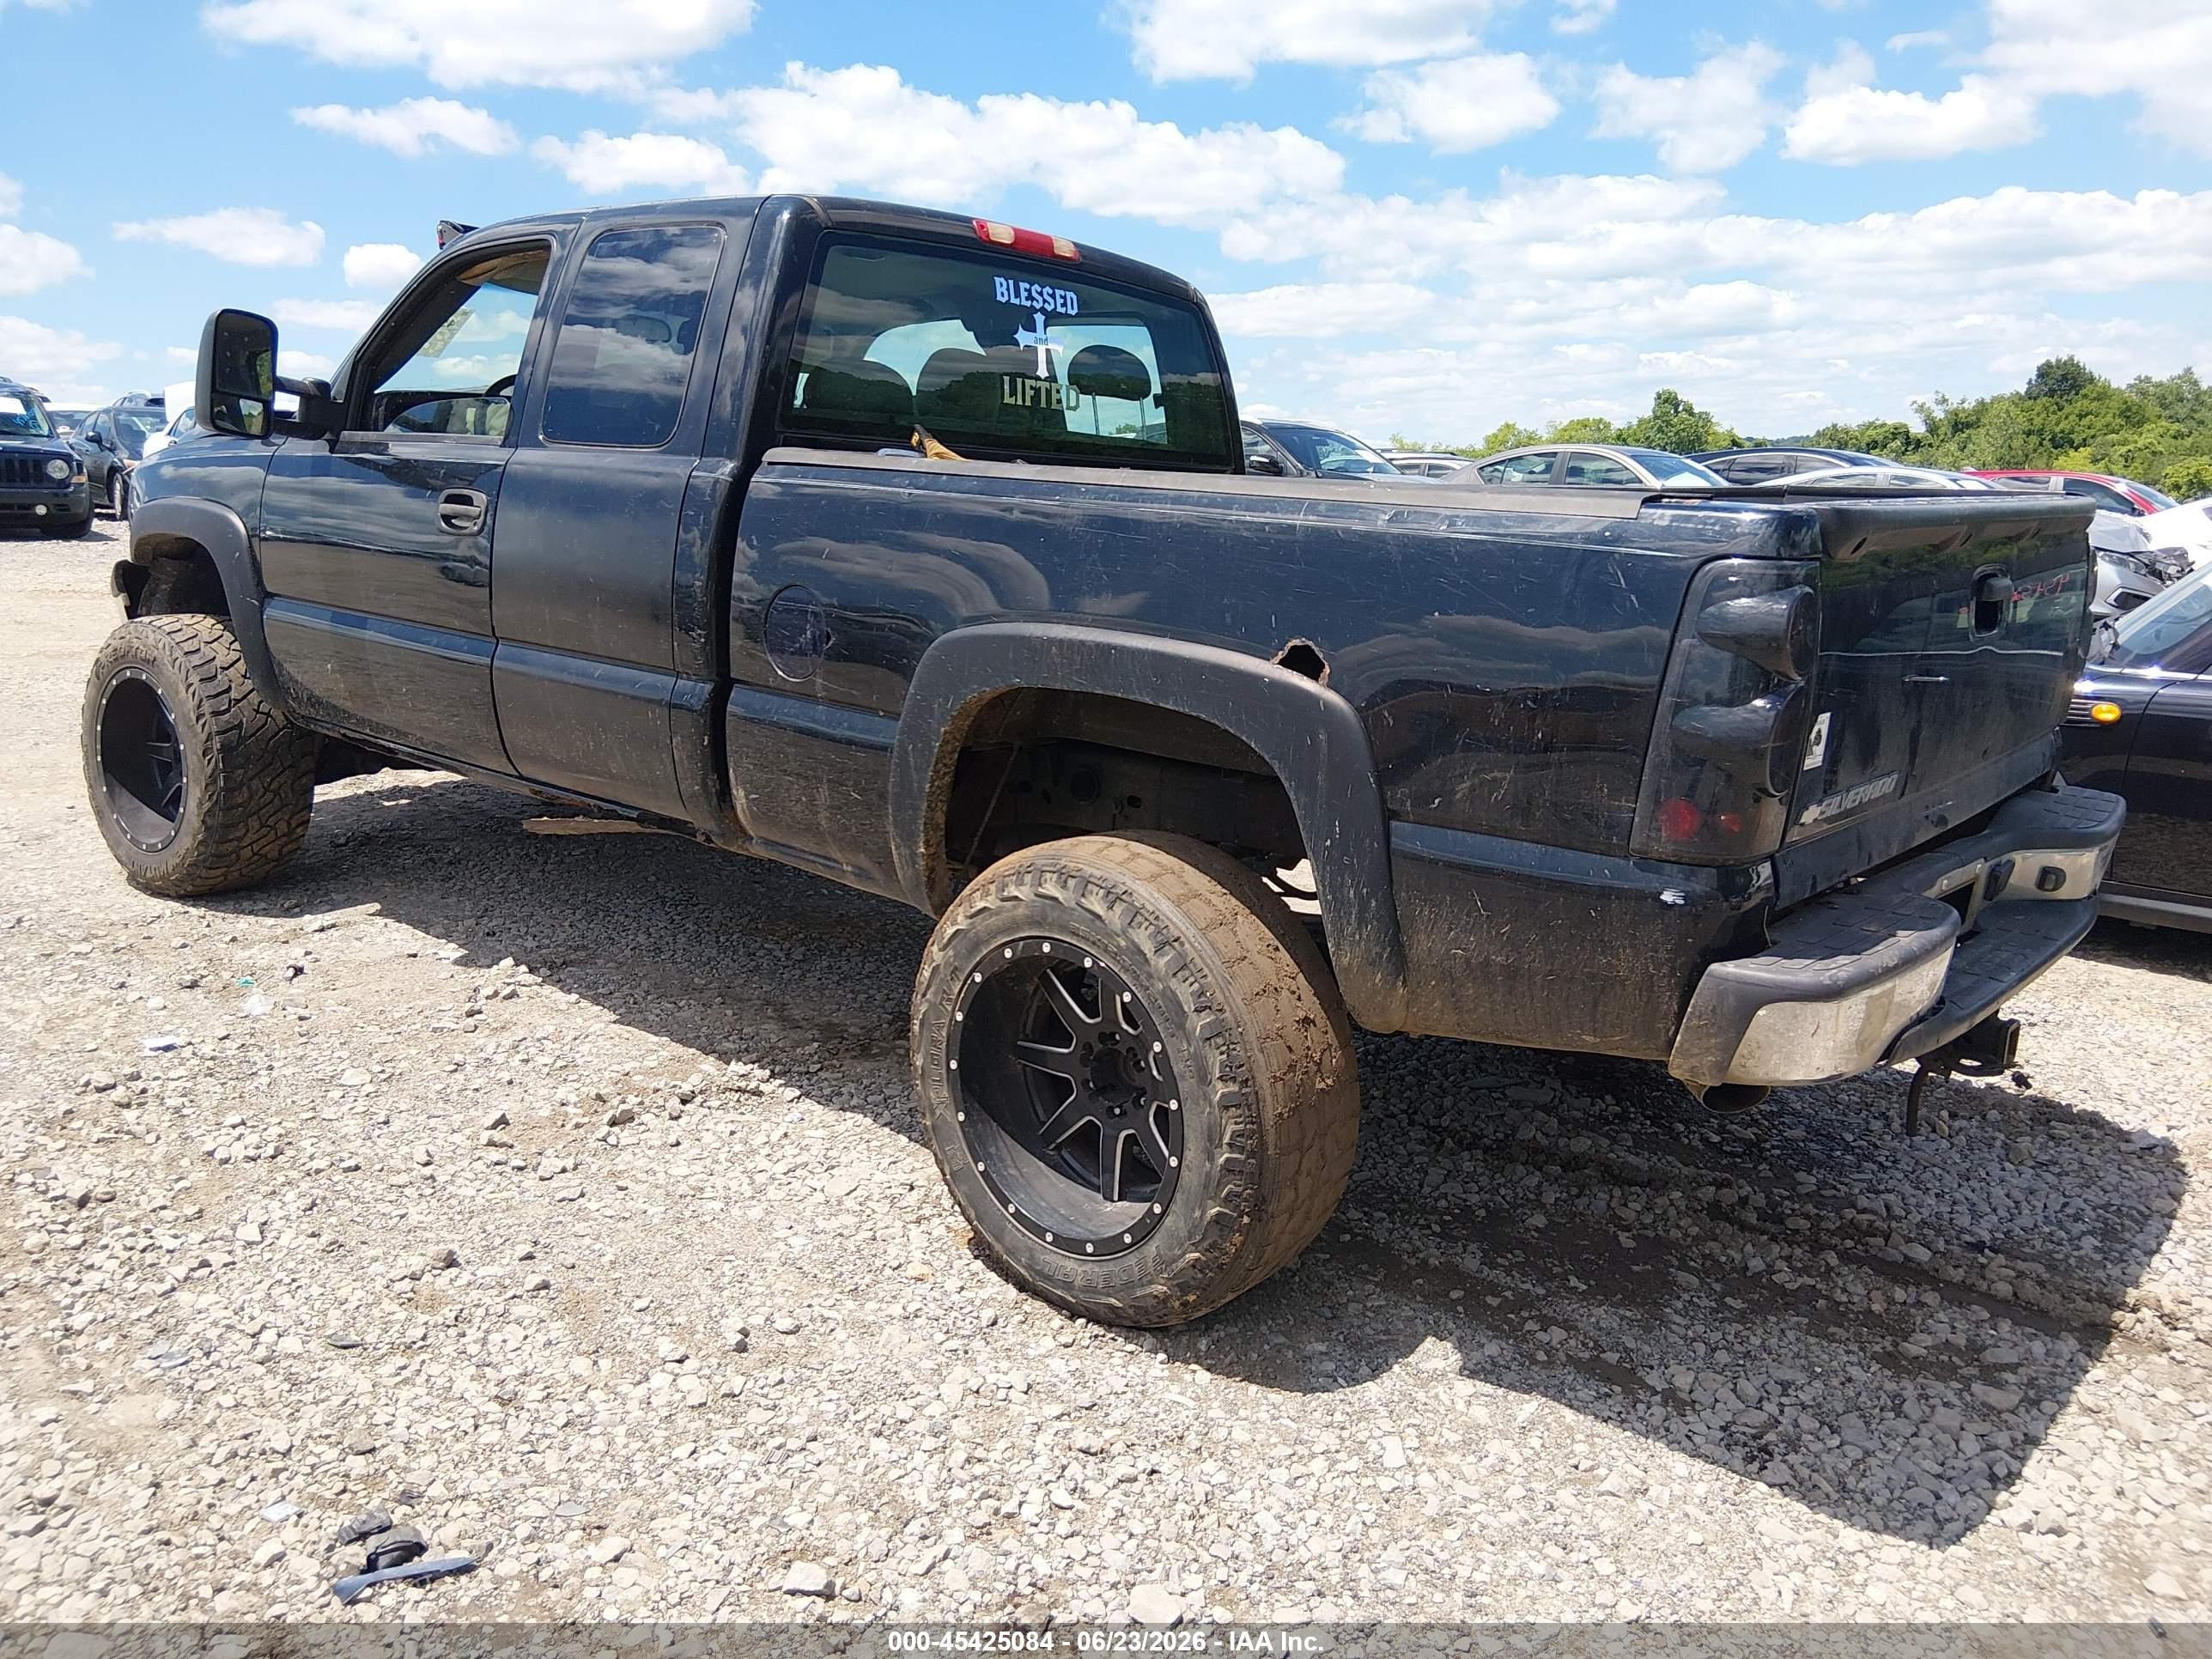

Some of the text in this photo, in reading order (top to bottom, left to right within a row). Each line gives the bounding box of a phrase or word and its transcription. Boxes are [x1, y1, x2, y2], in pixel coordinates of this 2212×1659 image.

[994, 276, 1079, 316] BLESSED
[1033, 336, 1048, 346] and
[1003, 375, 1081, 412] LIFTED
[1818, 774, 1898, 820] SILVERADO
[1042, 1244, 1165, 1289] FEDERAL
